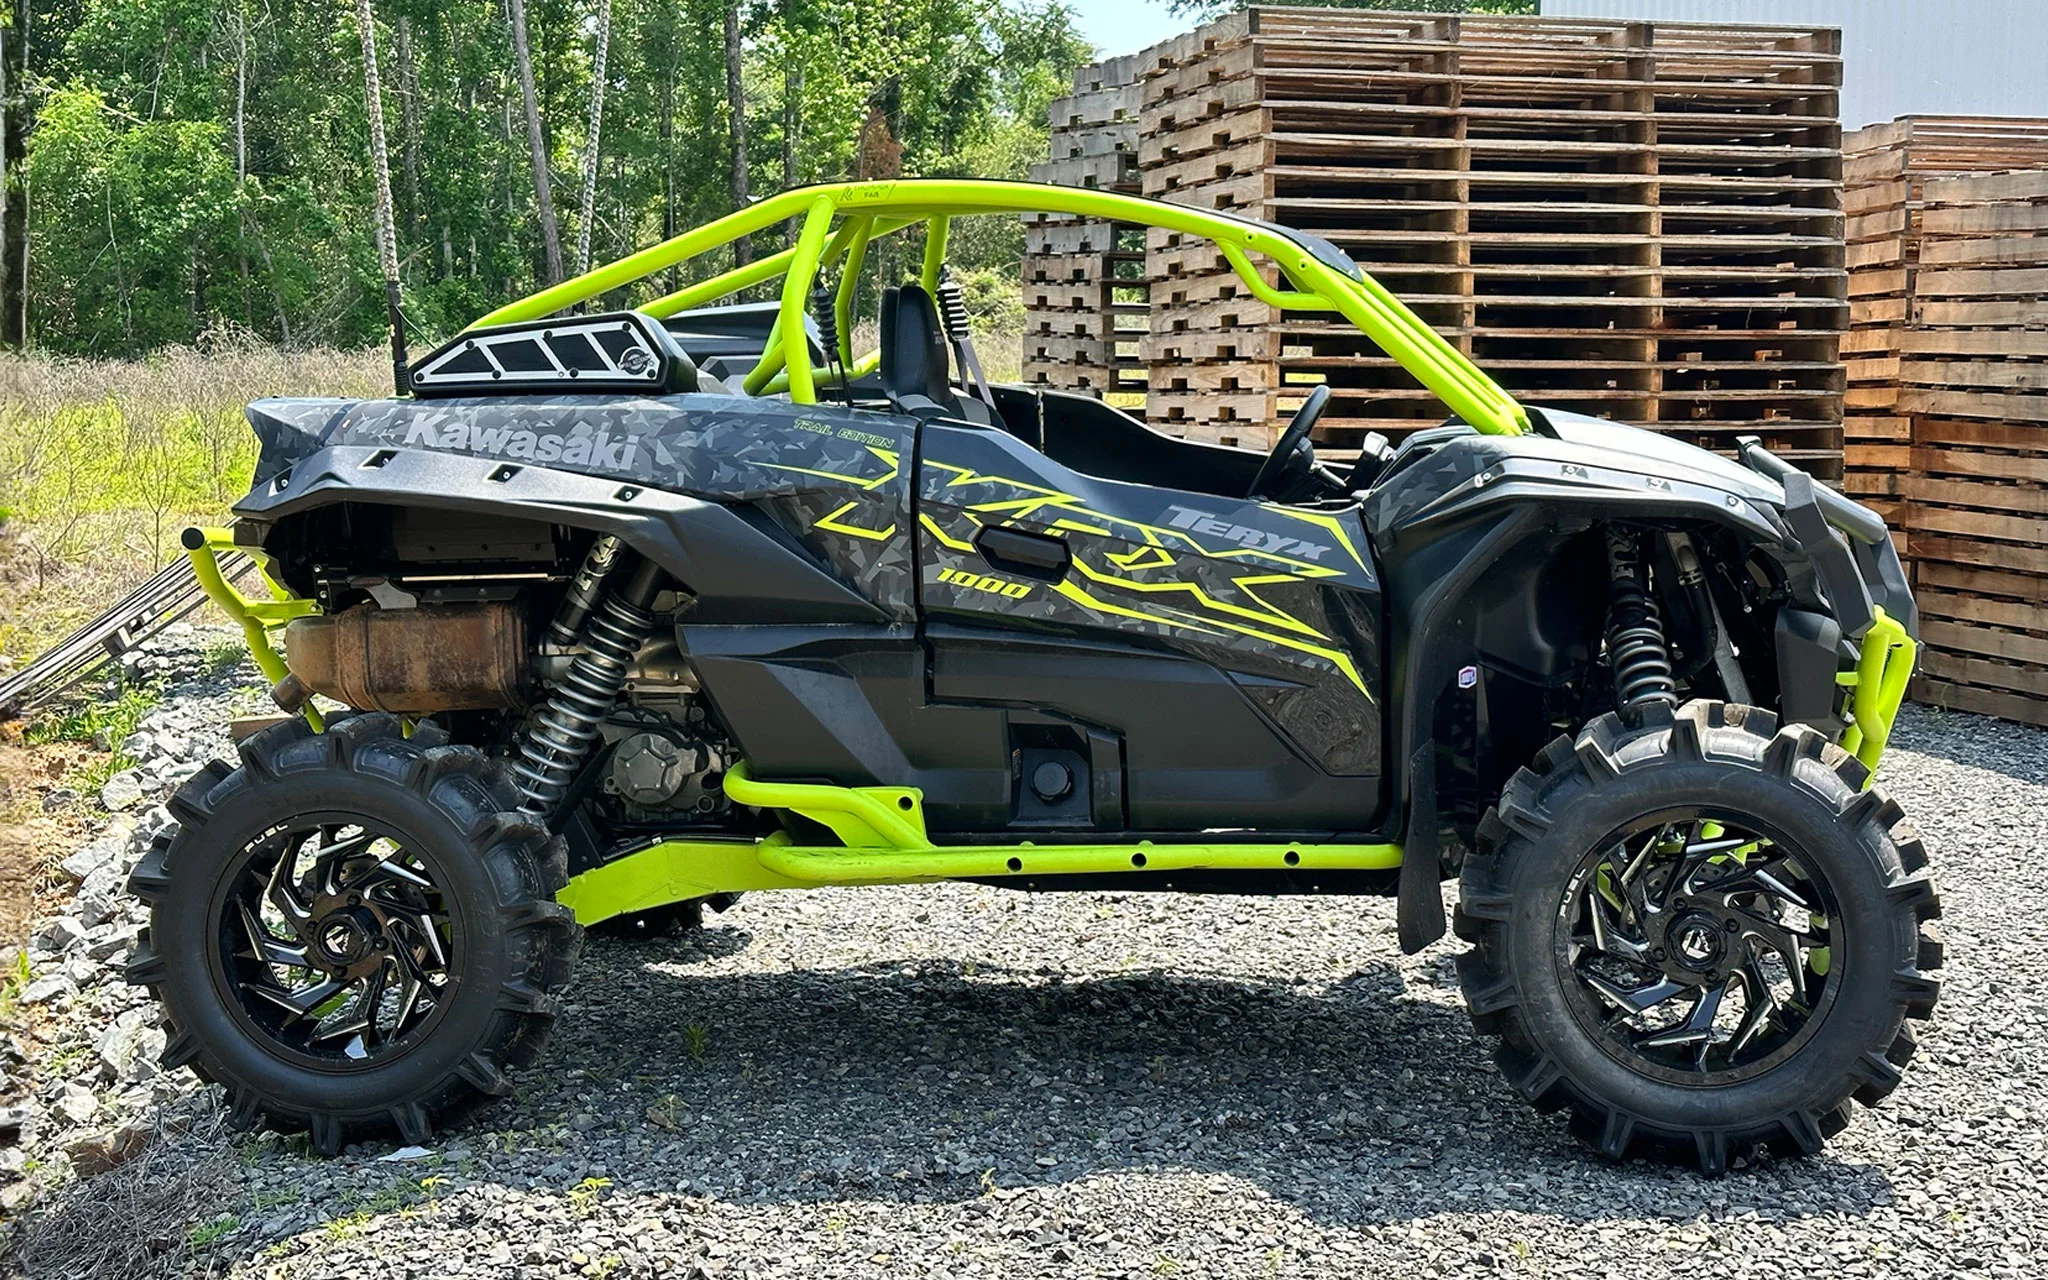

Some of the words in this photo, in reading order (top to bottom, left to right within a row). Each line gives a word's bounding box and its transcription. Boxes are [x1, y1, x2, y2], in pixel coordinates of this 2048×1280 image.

[404, 412, 639, 471] Kawasaki
[793, 419, 834, 436] TRAIL
[837, 428, 895, 449] EDITION
[1168, 504, 1332, 560] TERYX
[937, 567, 1032, 599] 1000
[244, 824, 289, 853] FUEL
[1560, 868, 1586, 918] FUEL
